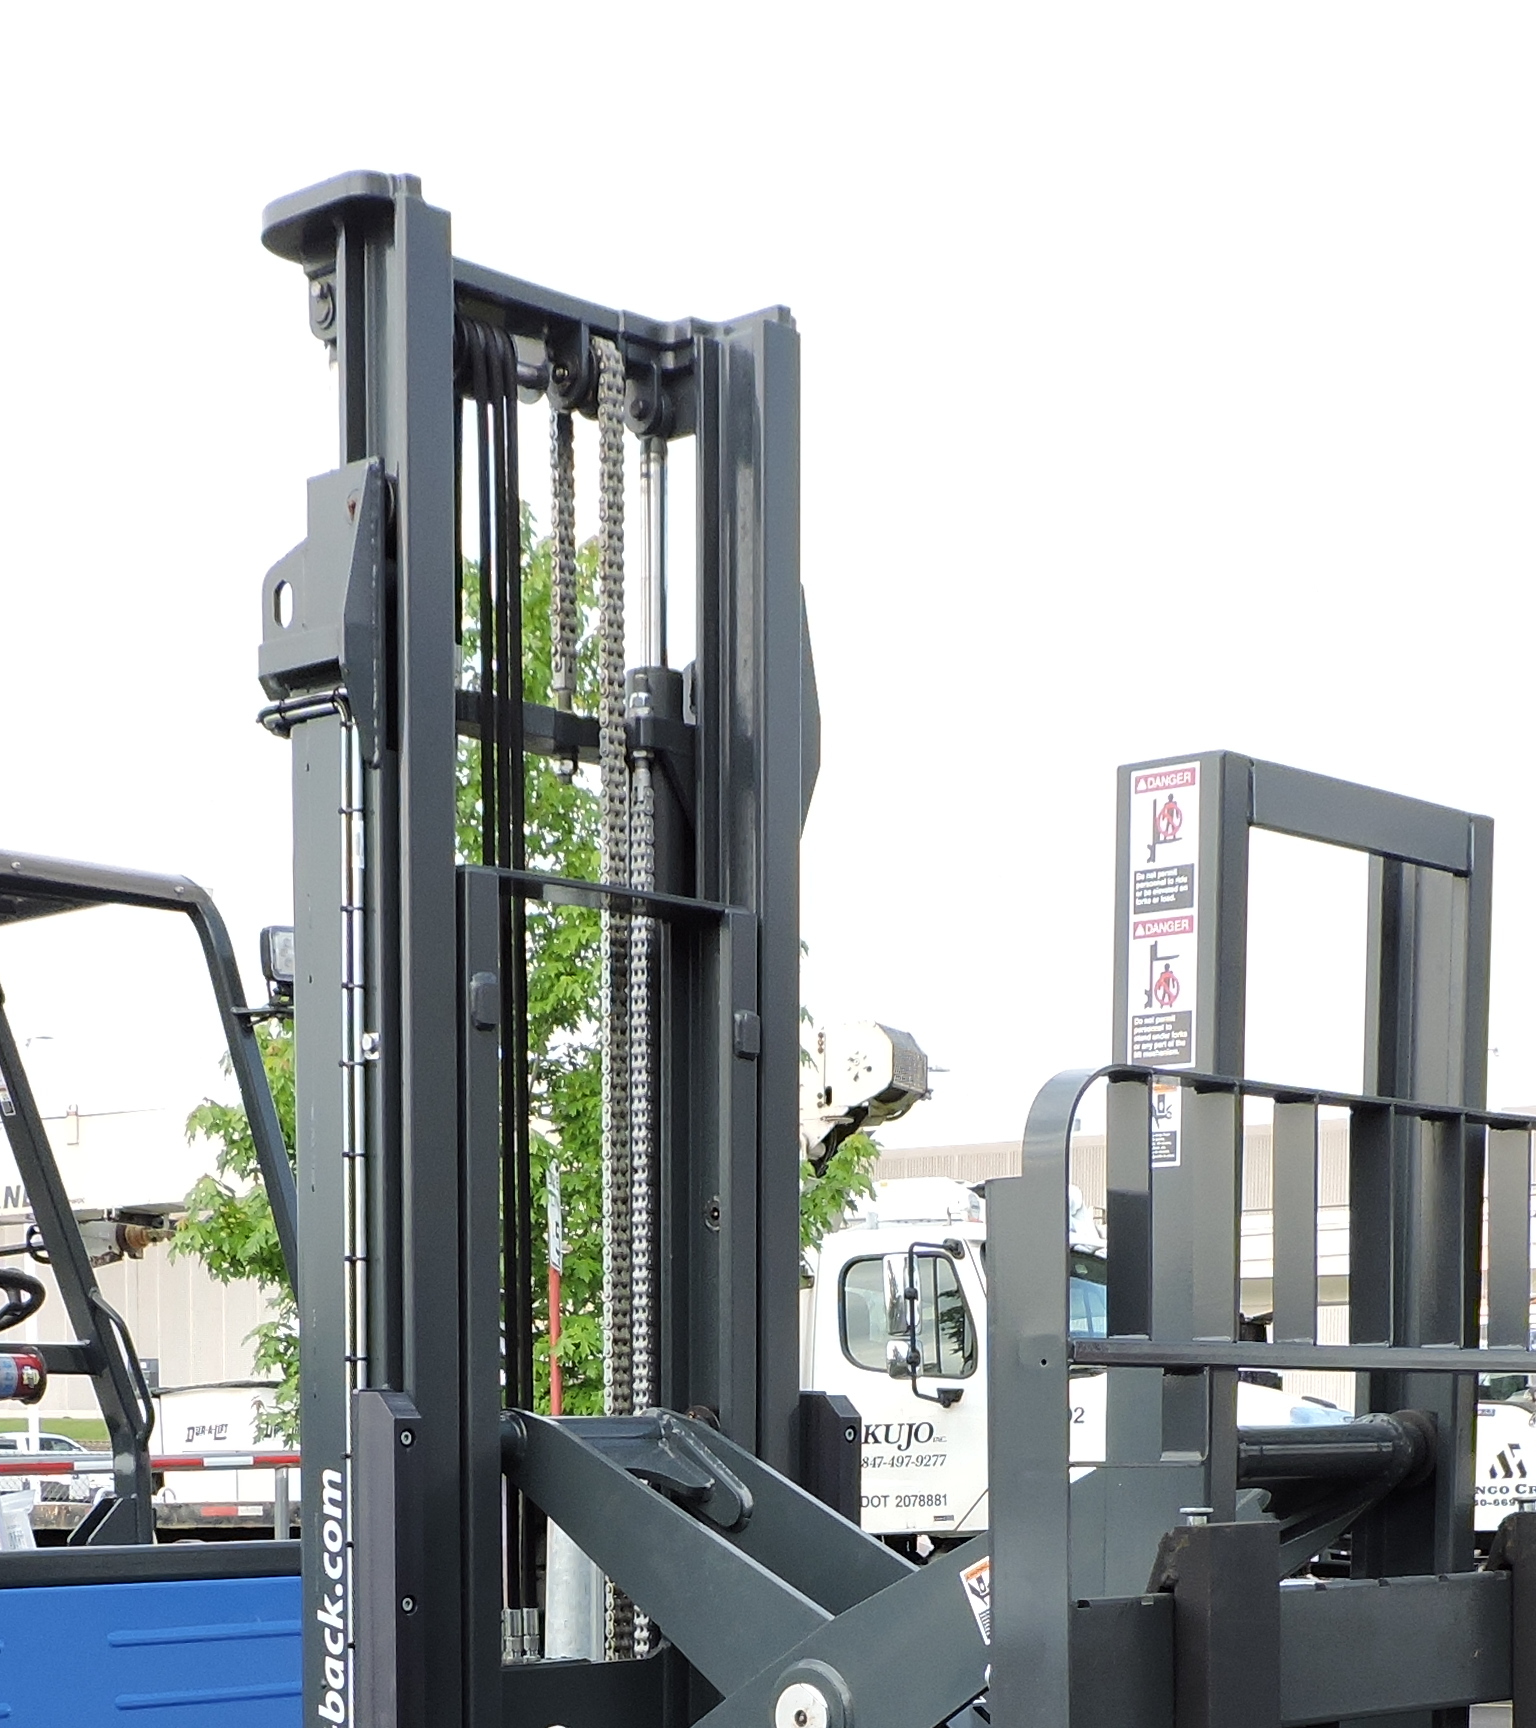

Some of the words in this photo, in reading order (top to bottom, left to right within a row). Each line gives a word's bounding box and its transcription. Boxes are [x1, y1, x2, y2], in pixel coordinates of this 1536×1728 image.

[1146, 771, 1191, 788] DANGER
[1145, 919, 1189, 935] DANGER
[861, 1422, 934, 1451] KUJO
[861, 1454, 947, 1468] 847-497-9277
[895, 1493, 947, 1508] 2078881
